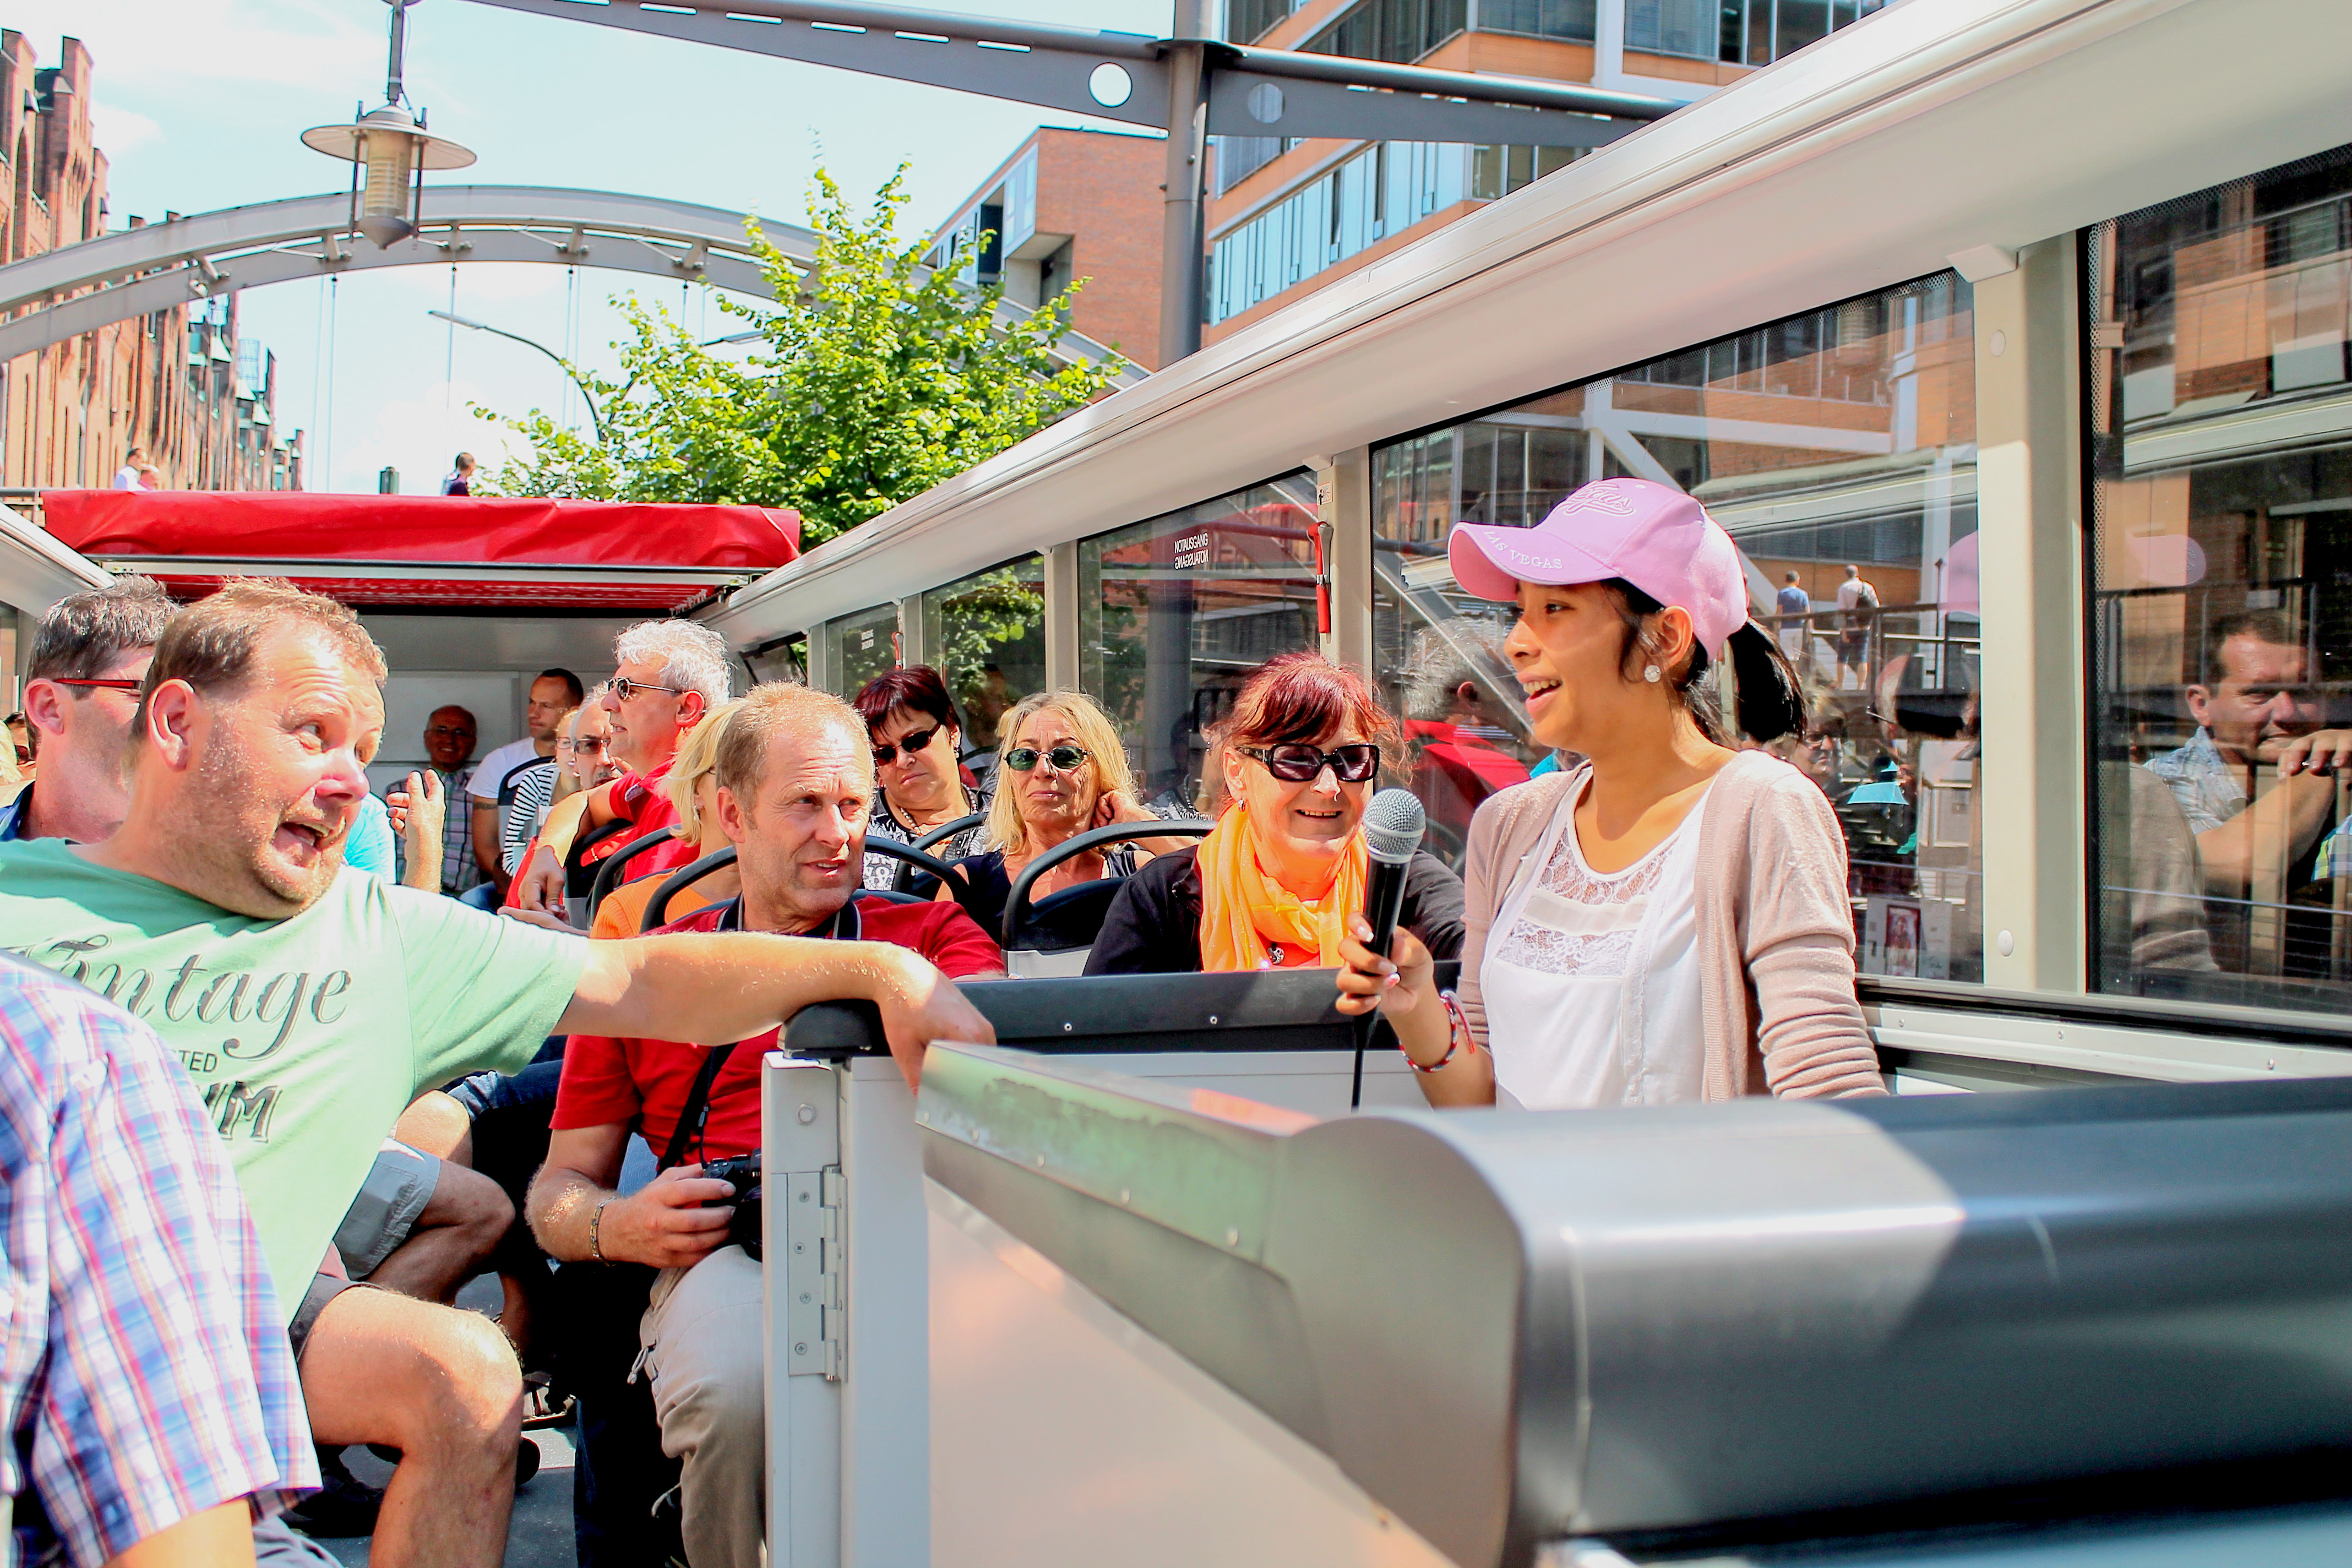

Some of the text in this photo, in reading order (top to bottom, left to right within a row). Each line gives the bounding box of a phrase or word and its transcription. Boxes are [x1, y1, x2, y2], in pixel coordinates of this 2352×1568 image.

[1174, 532, 1208, 554] NOTAUSGANG
[1484, 530, 1563, 569] LAS VEGAS
